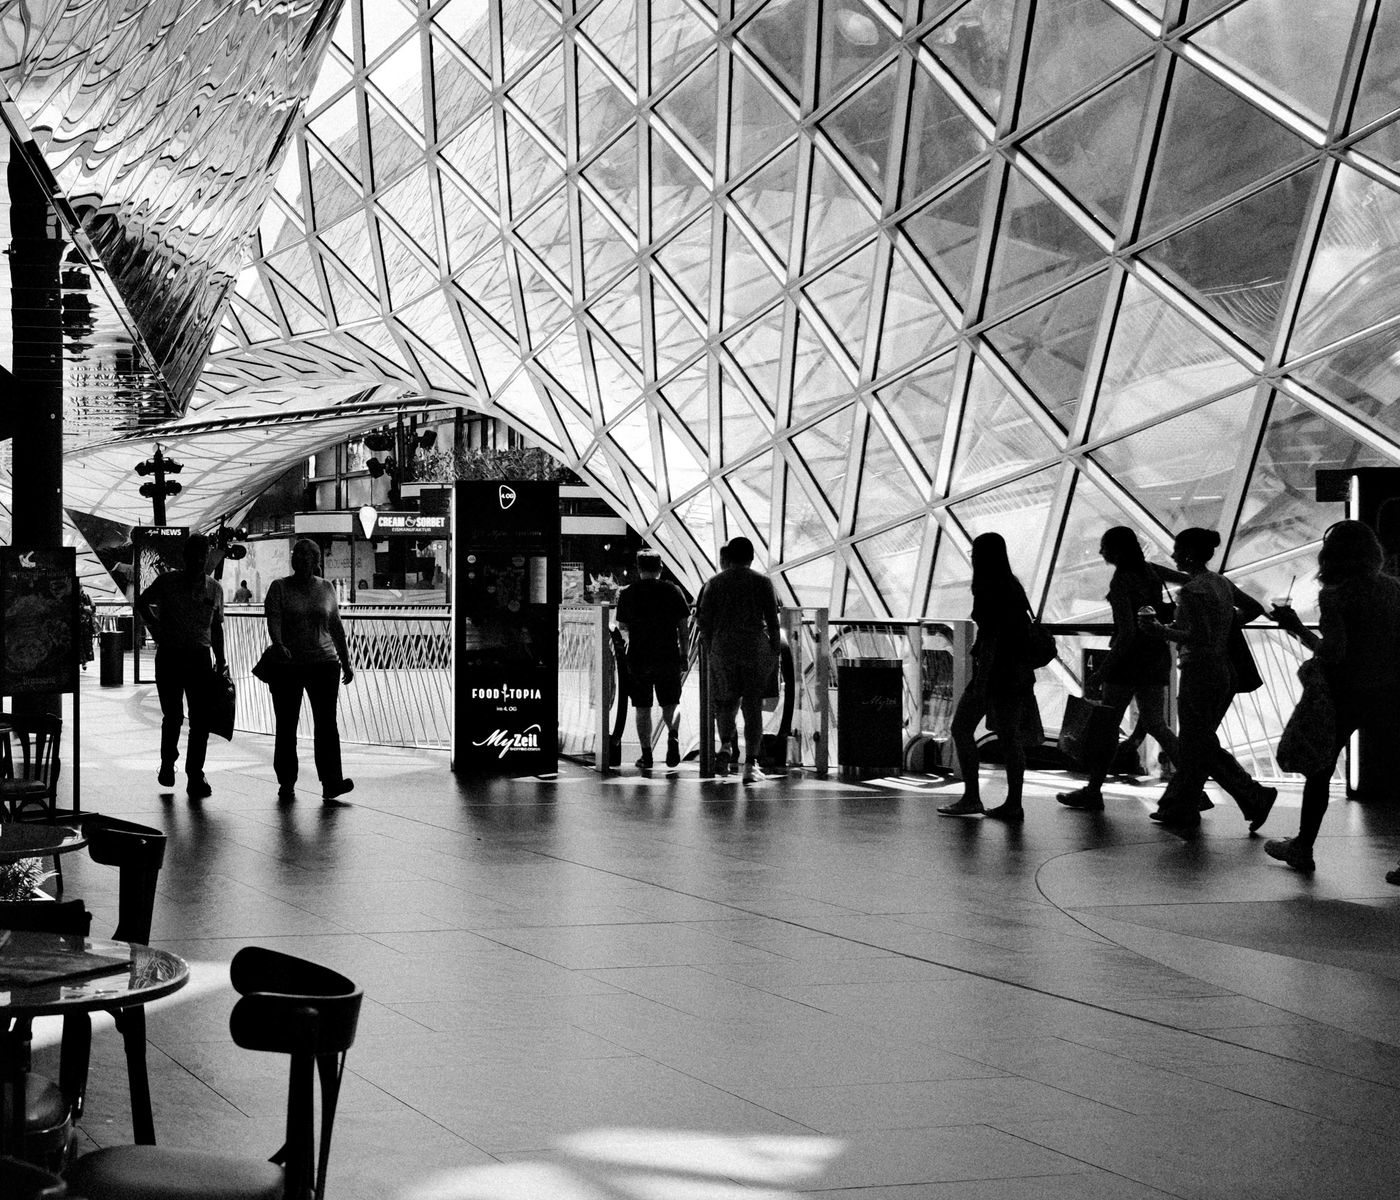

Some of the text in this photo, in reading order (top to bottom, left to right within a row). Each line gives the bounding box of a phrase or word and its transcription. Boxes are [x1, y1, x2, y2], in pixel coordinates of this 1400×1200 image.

[378, 516, 405, 527] CREAM
[416, 516, 445, 527] SORBET
[161, 528, 182, 536] NEWS
[472, 727, 540, 759] MyZeil
